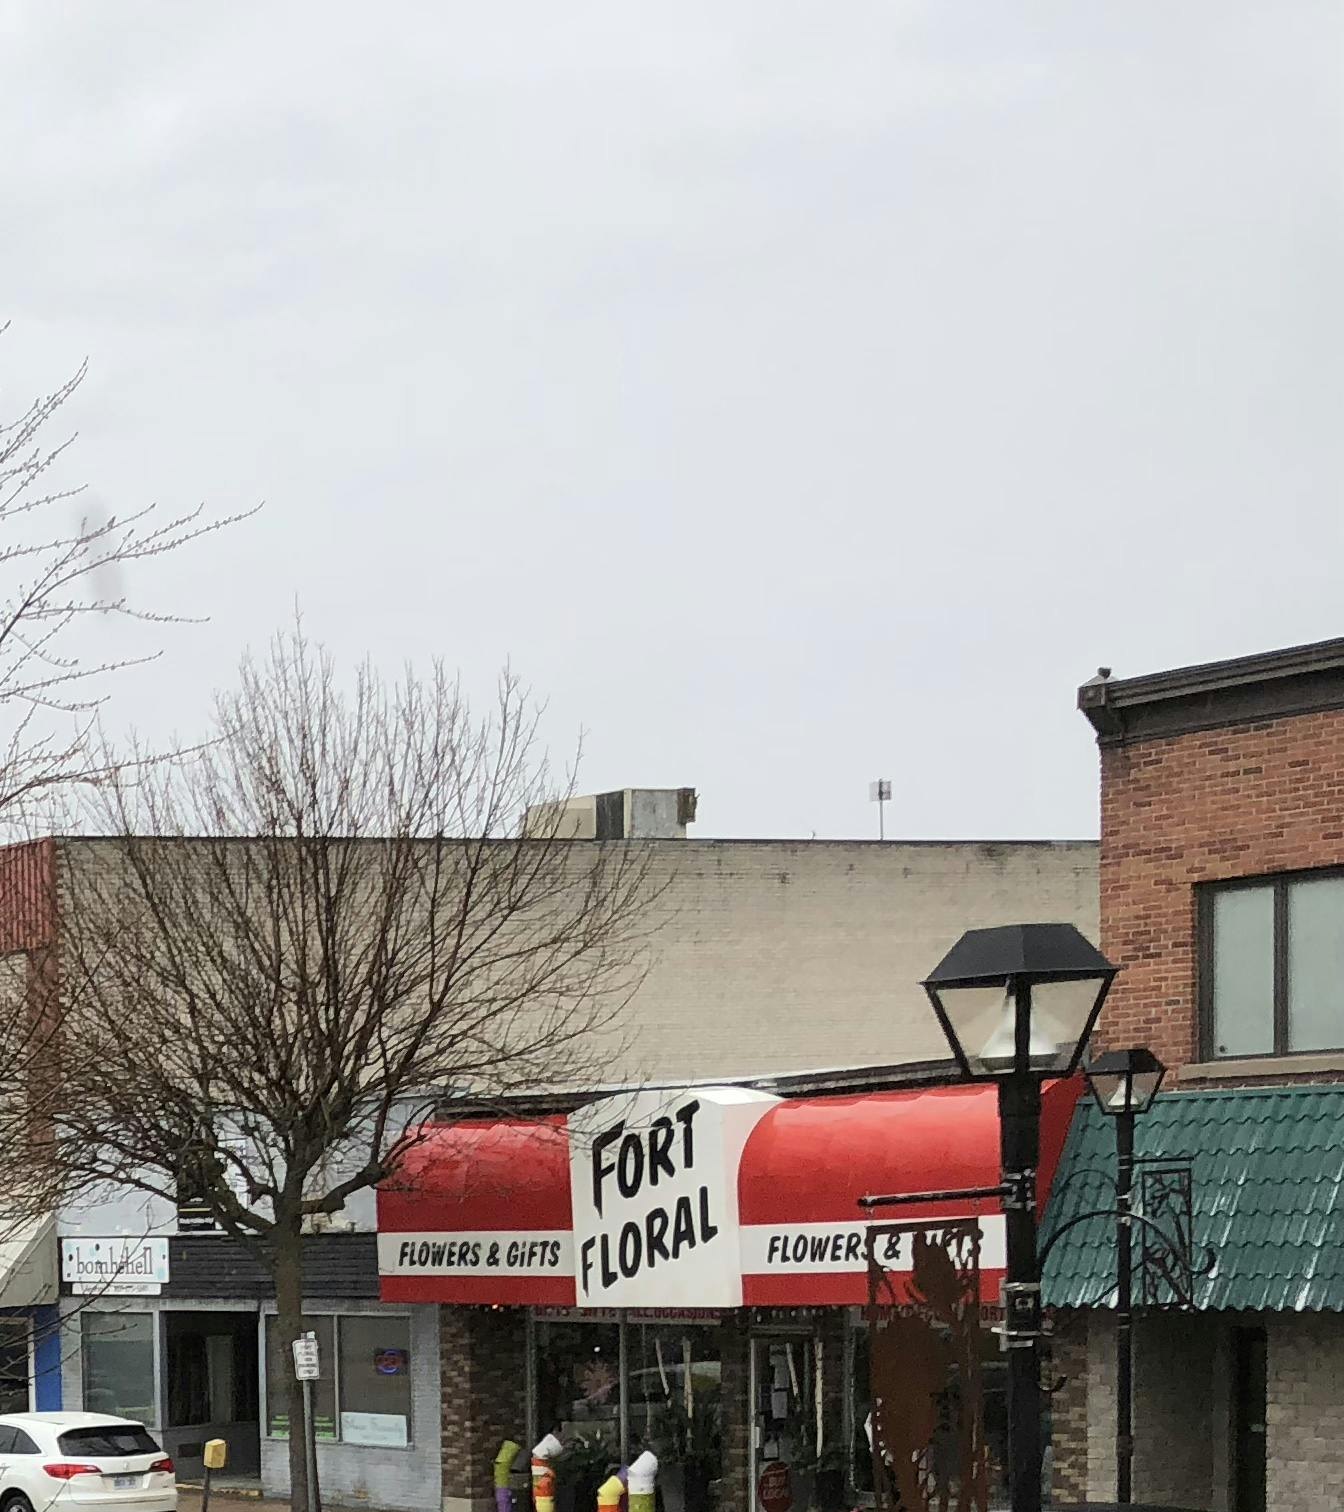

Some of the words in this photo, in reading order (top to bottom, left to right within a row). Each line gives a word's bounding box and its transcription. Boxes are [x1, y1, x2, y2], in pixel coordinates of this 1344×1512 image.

[591, 1099, 701, 1220] FORT
[398, 1240, 481, 1267] FLOWERS
[486, 1240, 500, 1267] &
[580, 1185, 719, 1299] FLORAL
[884, 1231, 902, 1260] &
[75, 1246, 153, 1275] bombshell
